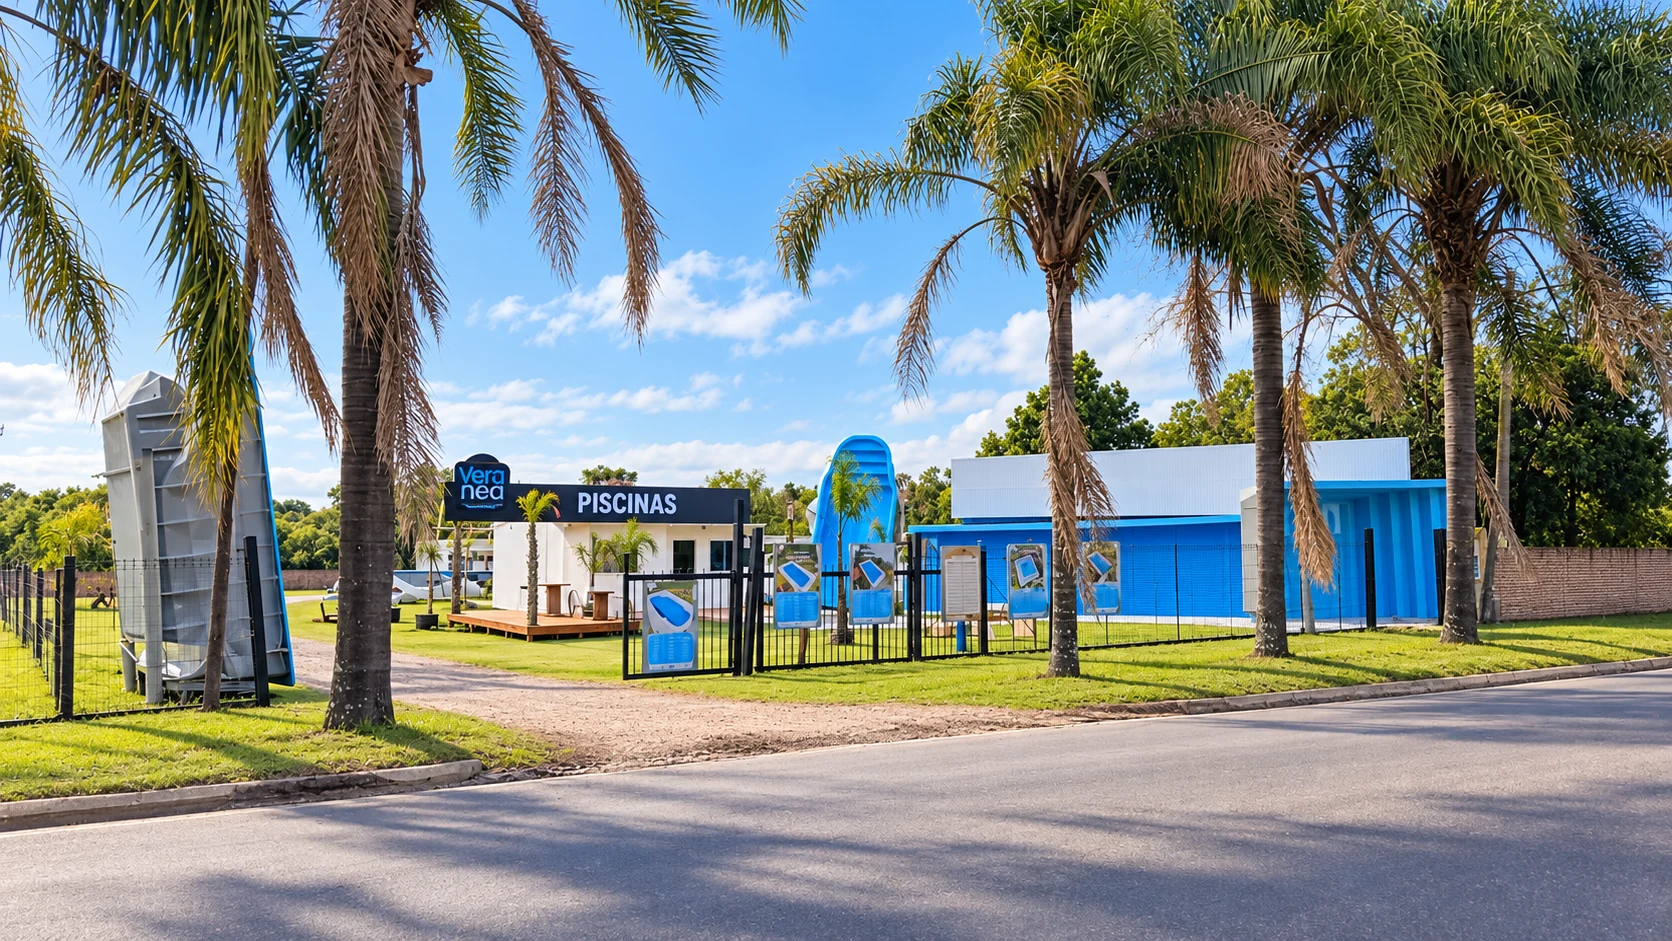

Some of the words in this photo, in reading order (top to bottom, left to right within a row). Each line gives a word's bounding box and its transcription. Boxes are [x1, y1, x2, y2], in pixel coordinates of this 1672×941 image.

[459, 466, 504, 485] Vera
[461, 484, 504, 500] nea
[578, 492, 677, 514] PISCINAS
